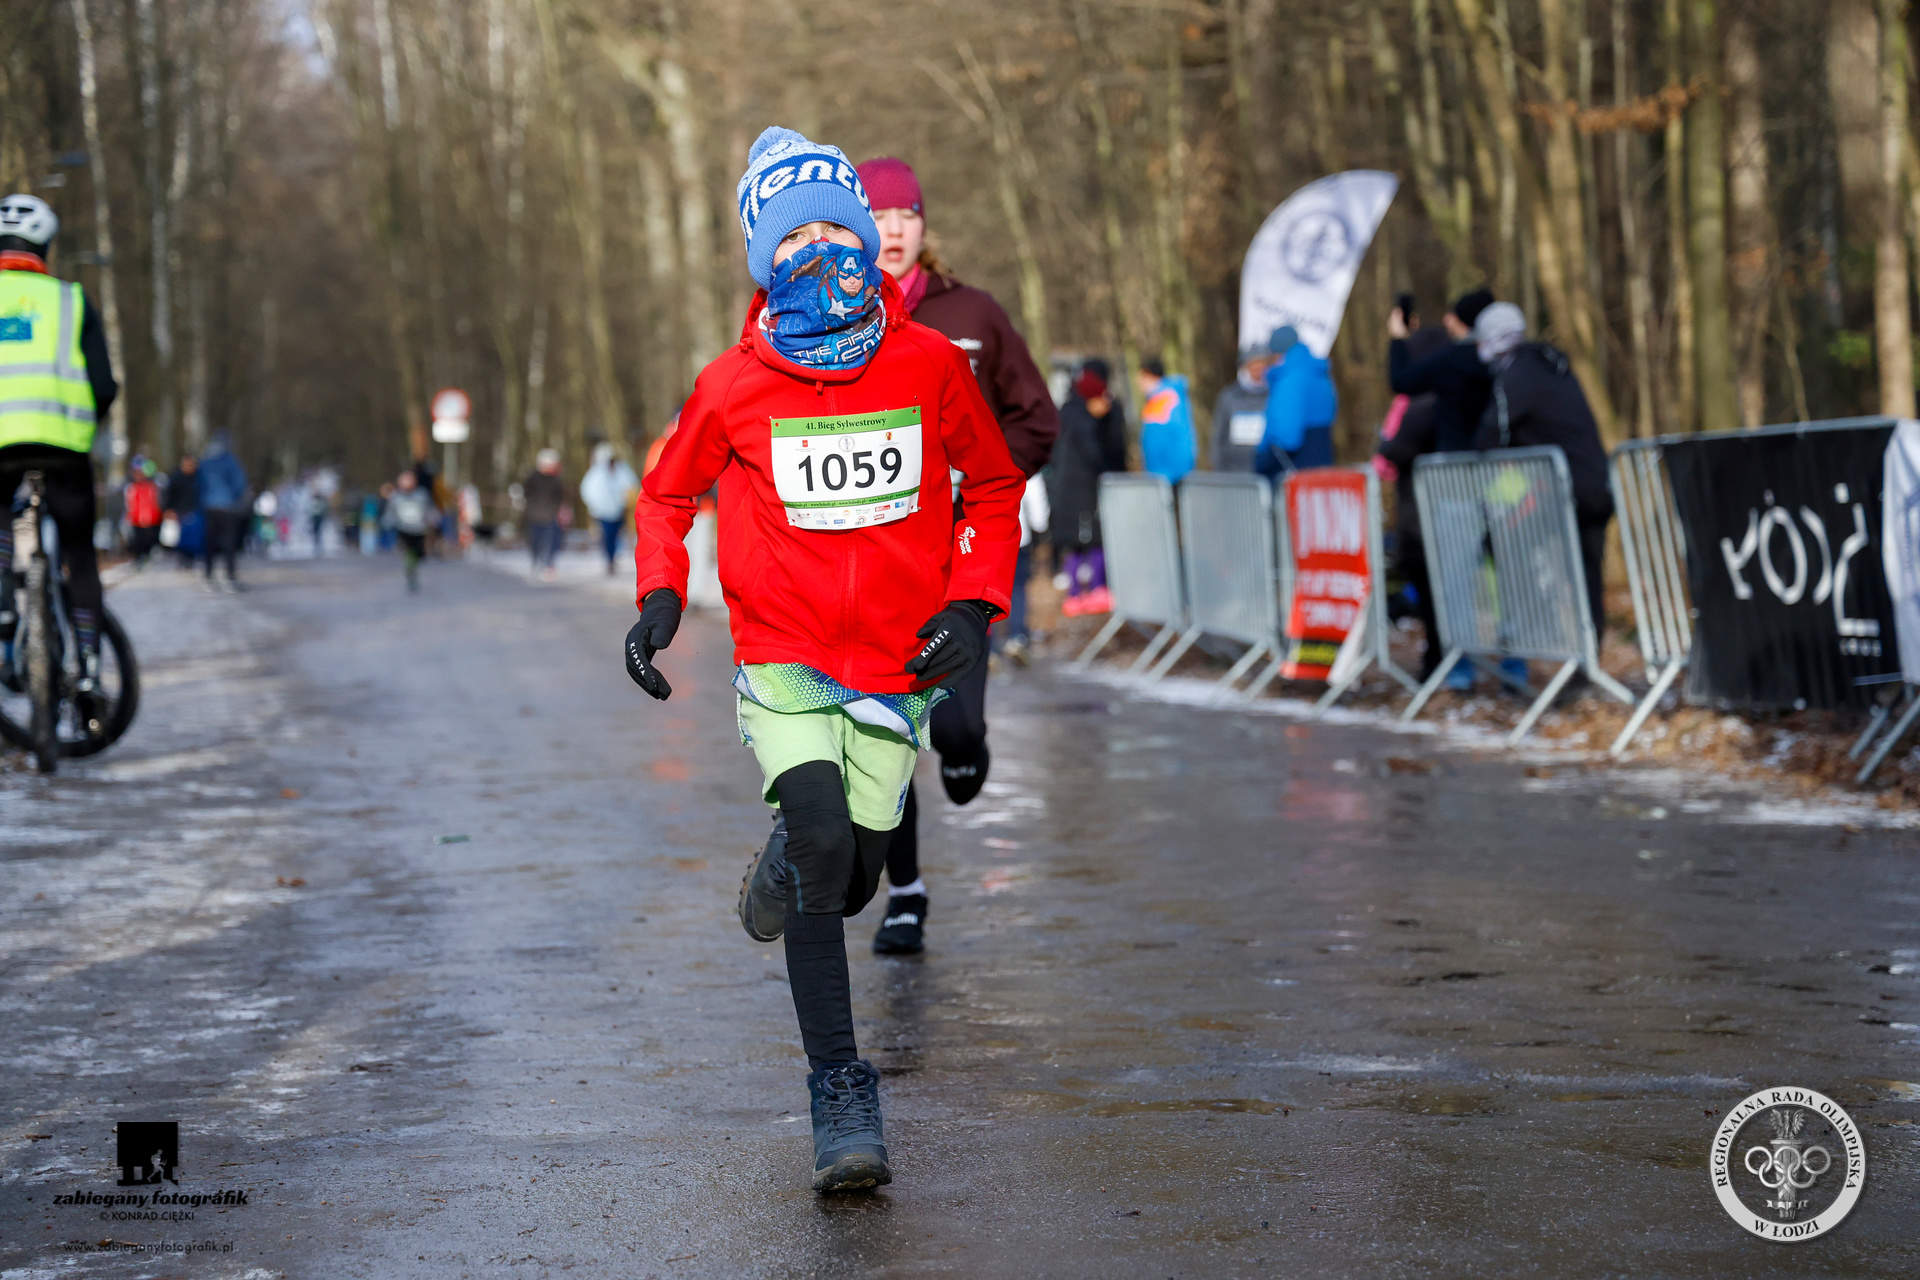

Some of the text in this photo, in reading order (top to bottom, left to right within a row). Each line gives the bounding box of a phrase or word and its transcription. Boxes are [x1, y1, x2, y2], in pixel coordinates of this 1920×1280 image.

[793, 345, 823, 359] THE
[836, 317, 880, 352] FIRST
[805, 418, 887, 431] 41. Bieg Sylwestrowy
[798, 447, 902, 492] 1059
[921, 630, 949, 658] KIPSTA
